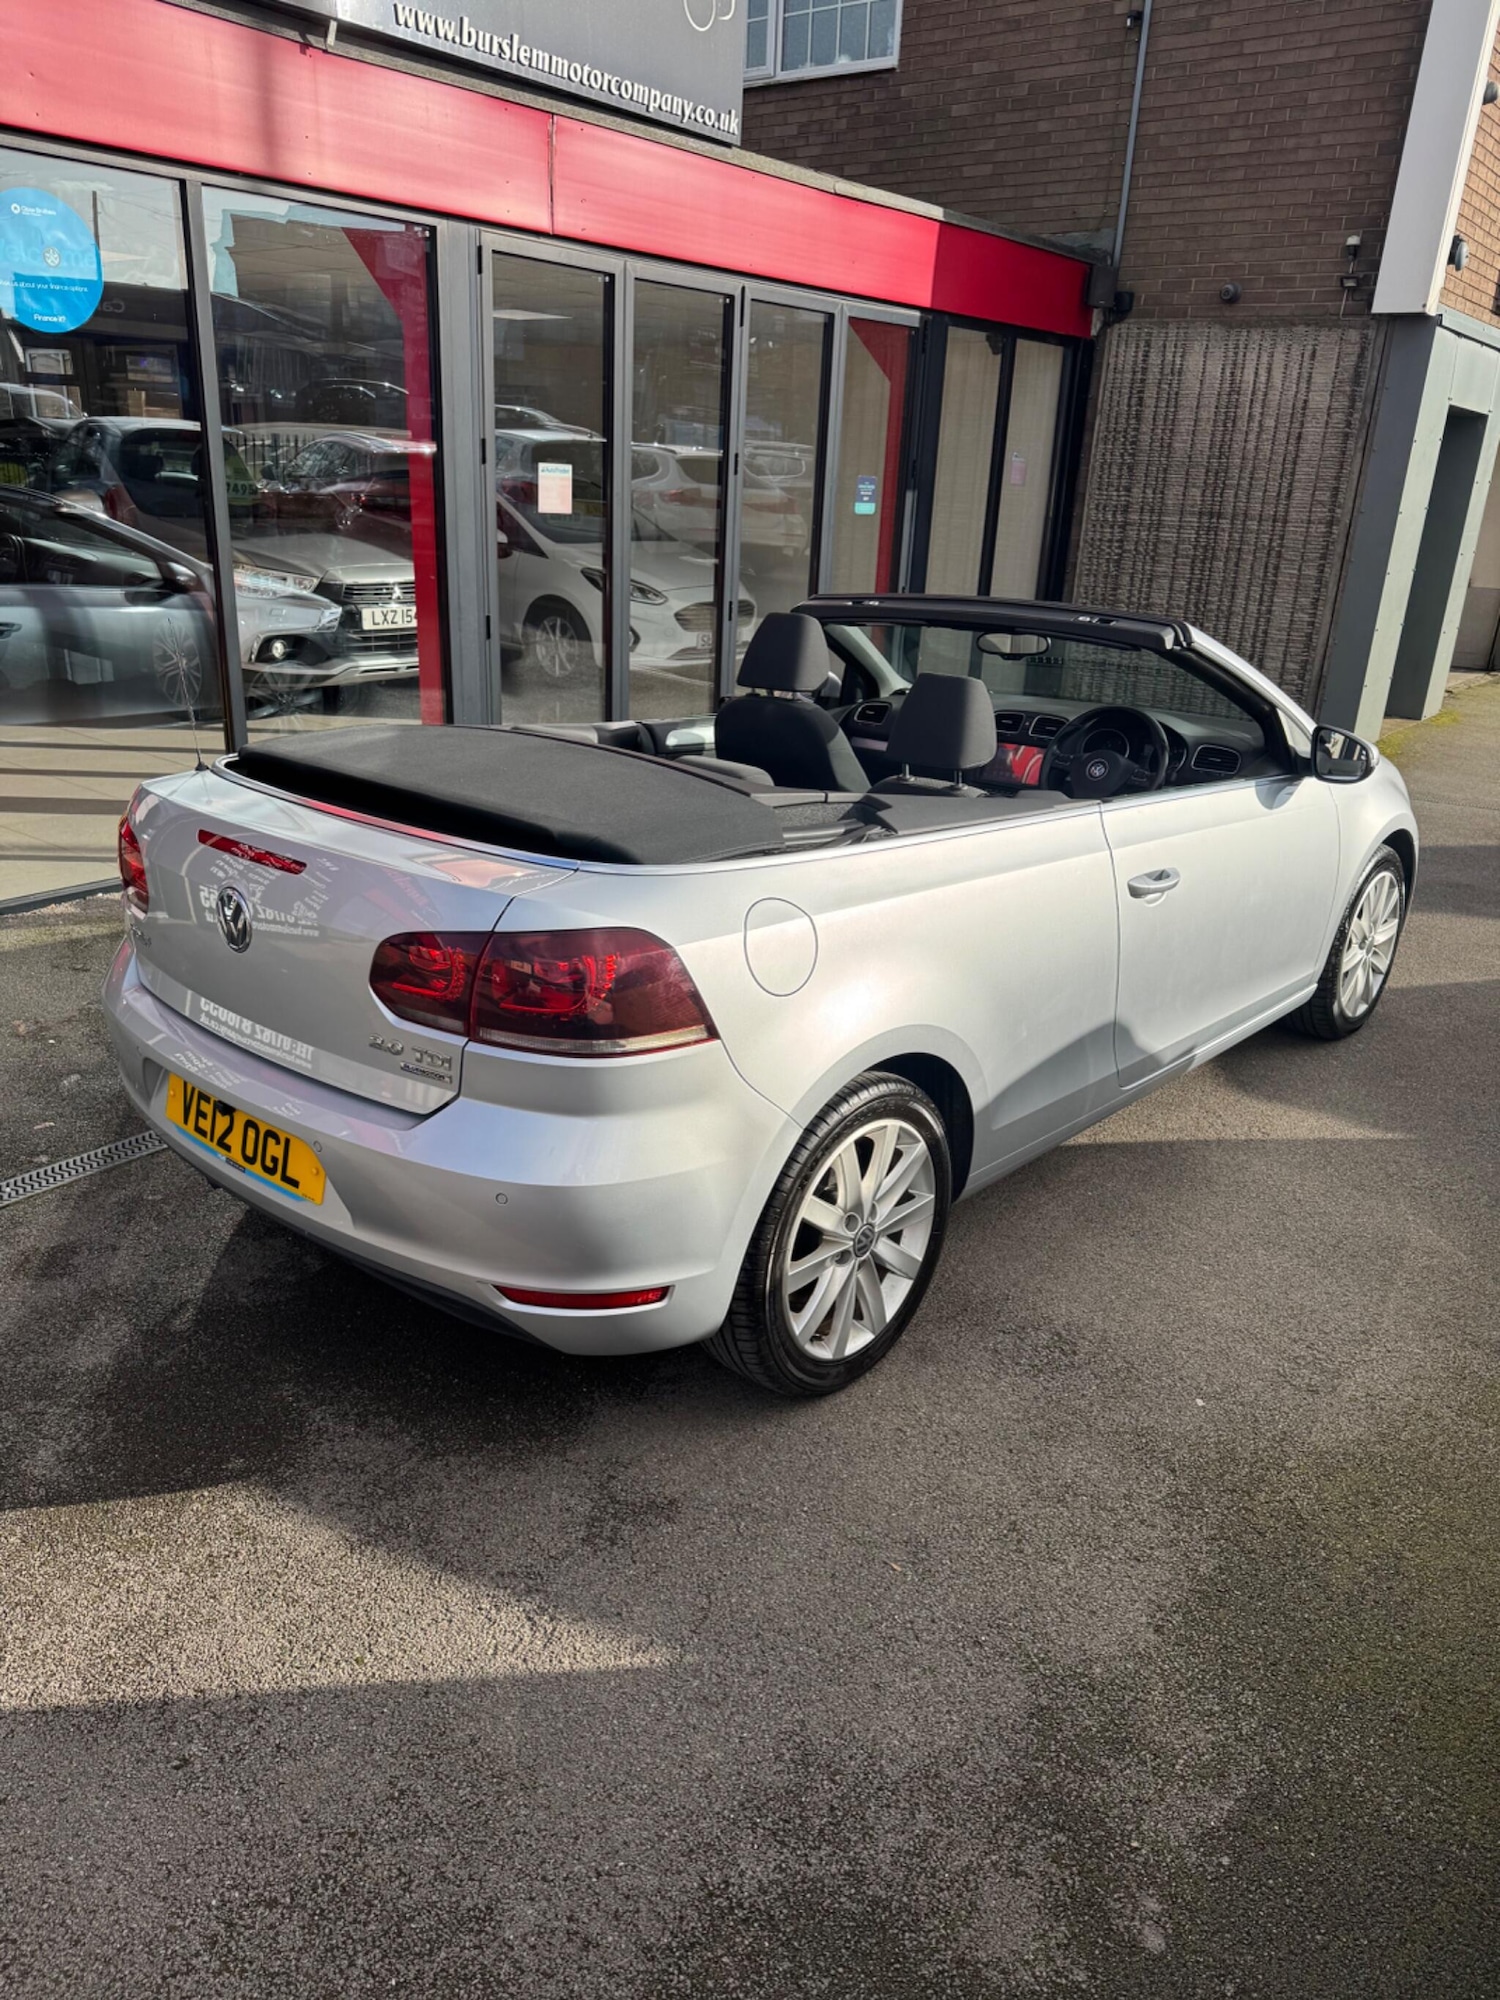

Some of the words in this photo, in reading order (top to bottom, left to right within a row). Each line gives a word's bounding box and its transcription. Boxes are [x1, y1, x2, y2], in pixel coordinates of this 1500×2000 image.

[393, 3, 739, 136] www.burslemmotorcompany.co.uk
[371, 609, 398, 626] LXZ
[411, 1045, 453, 1072] TDI
[240, 1118, 300, 1190] OGL
